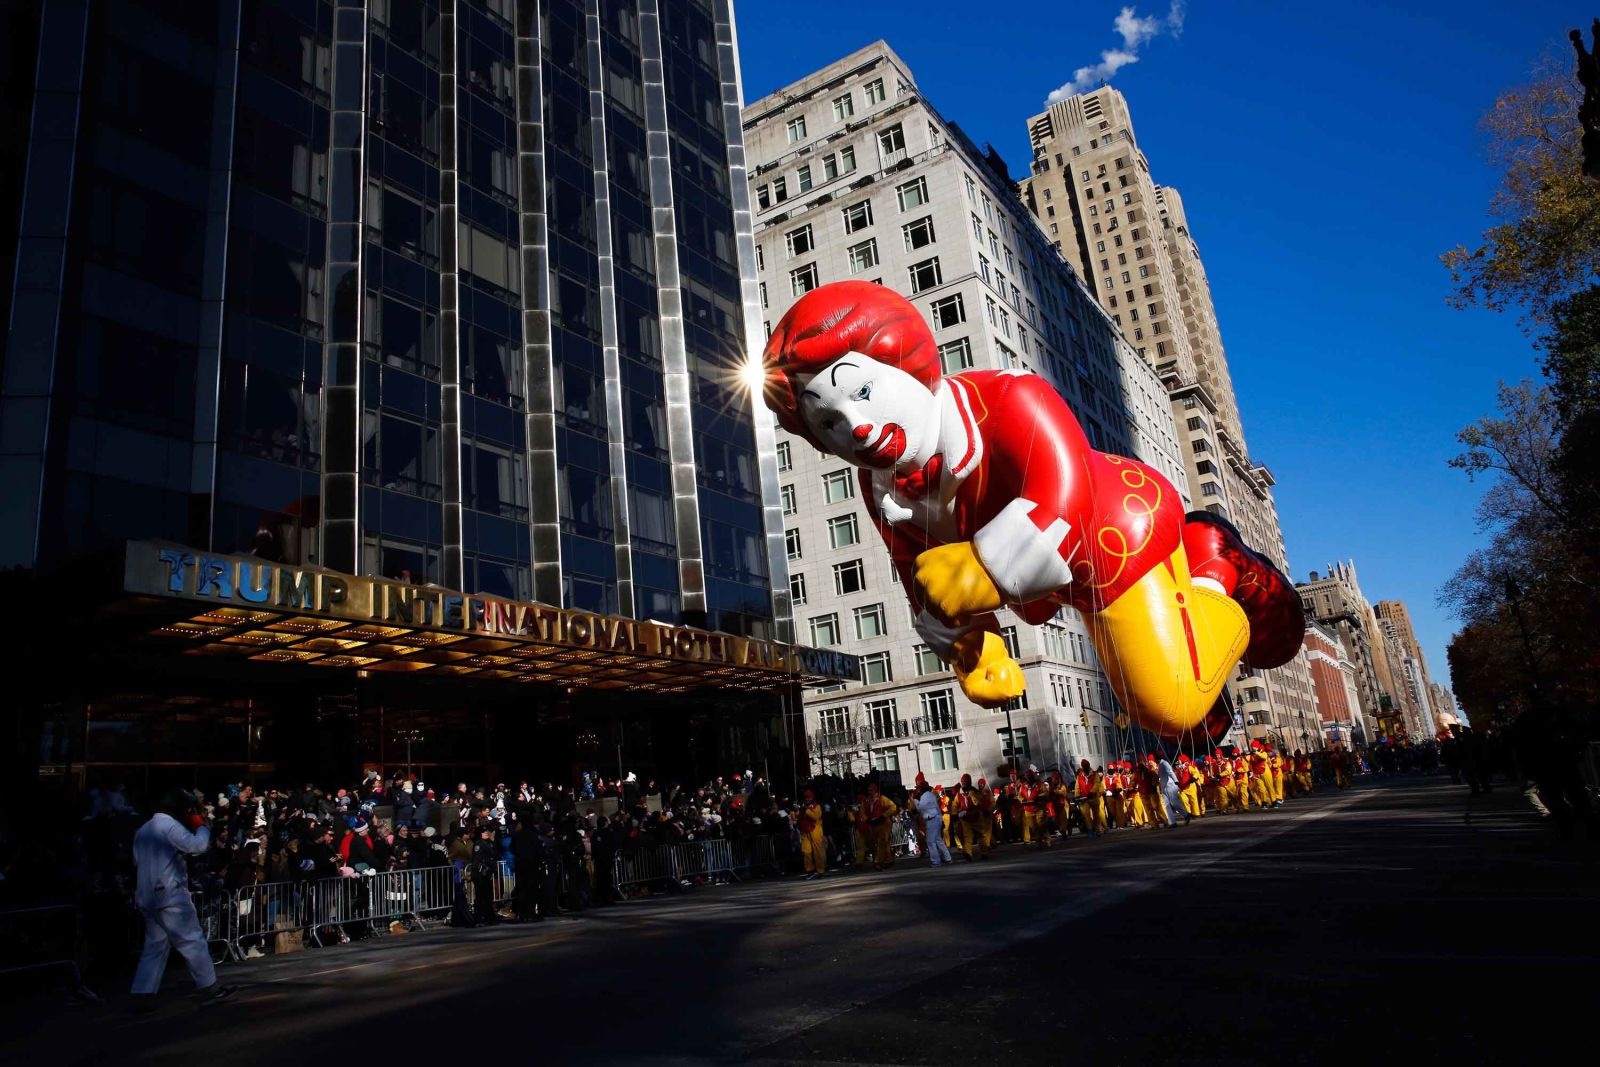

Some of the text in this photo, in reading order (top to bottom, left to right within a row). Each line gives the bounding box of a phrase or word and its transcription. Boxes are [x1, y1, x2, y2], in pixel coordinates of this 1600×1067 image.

[159, 549, 348, 612] TRUMP
[370, 582, 649, 653] INTERNATIONAL
[657, 627, 733, 665] HOTEL
[790, 648, 855, 677] TOWER
